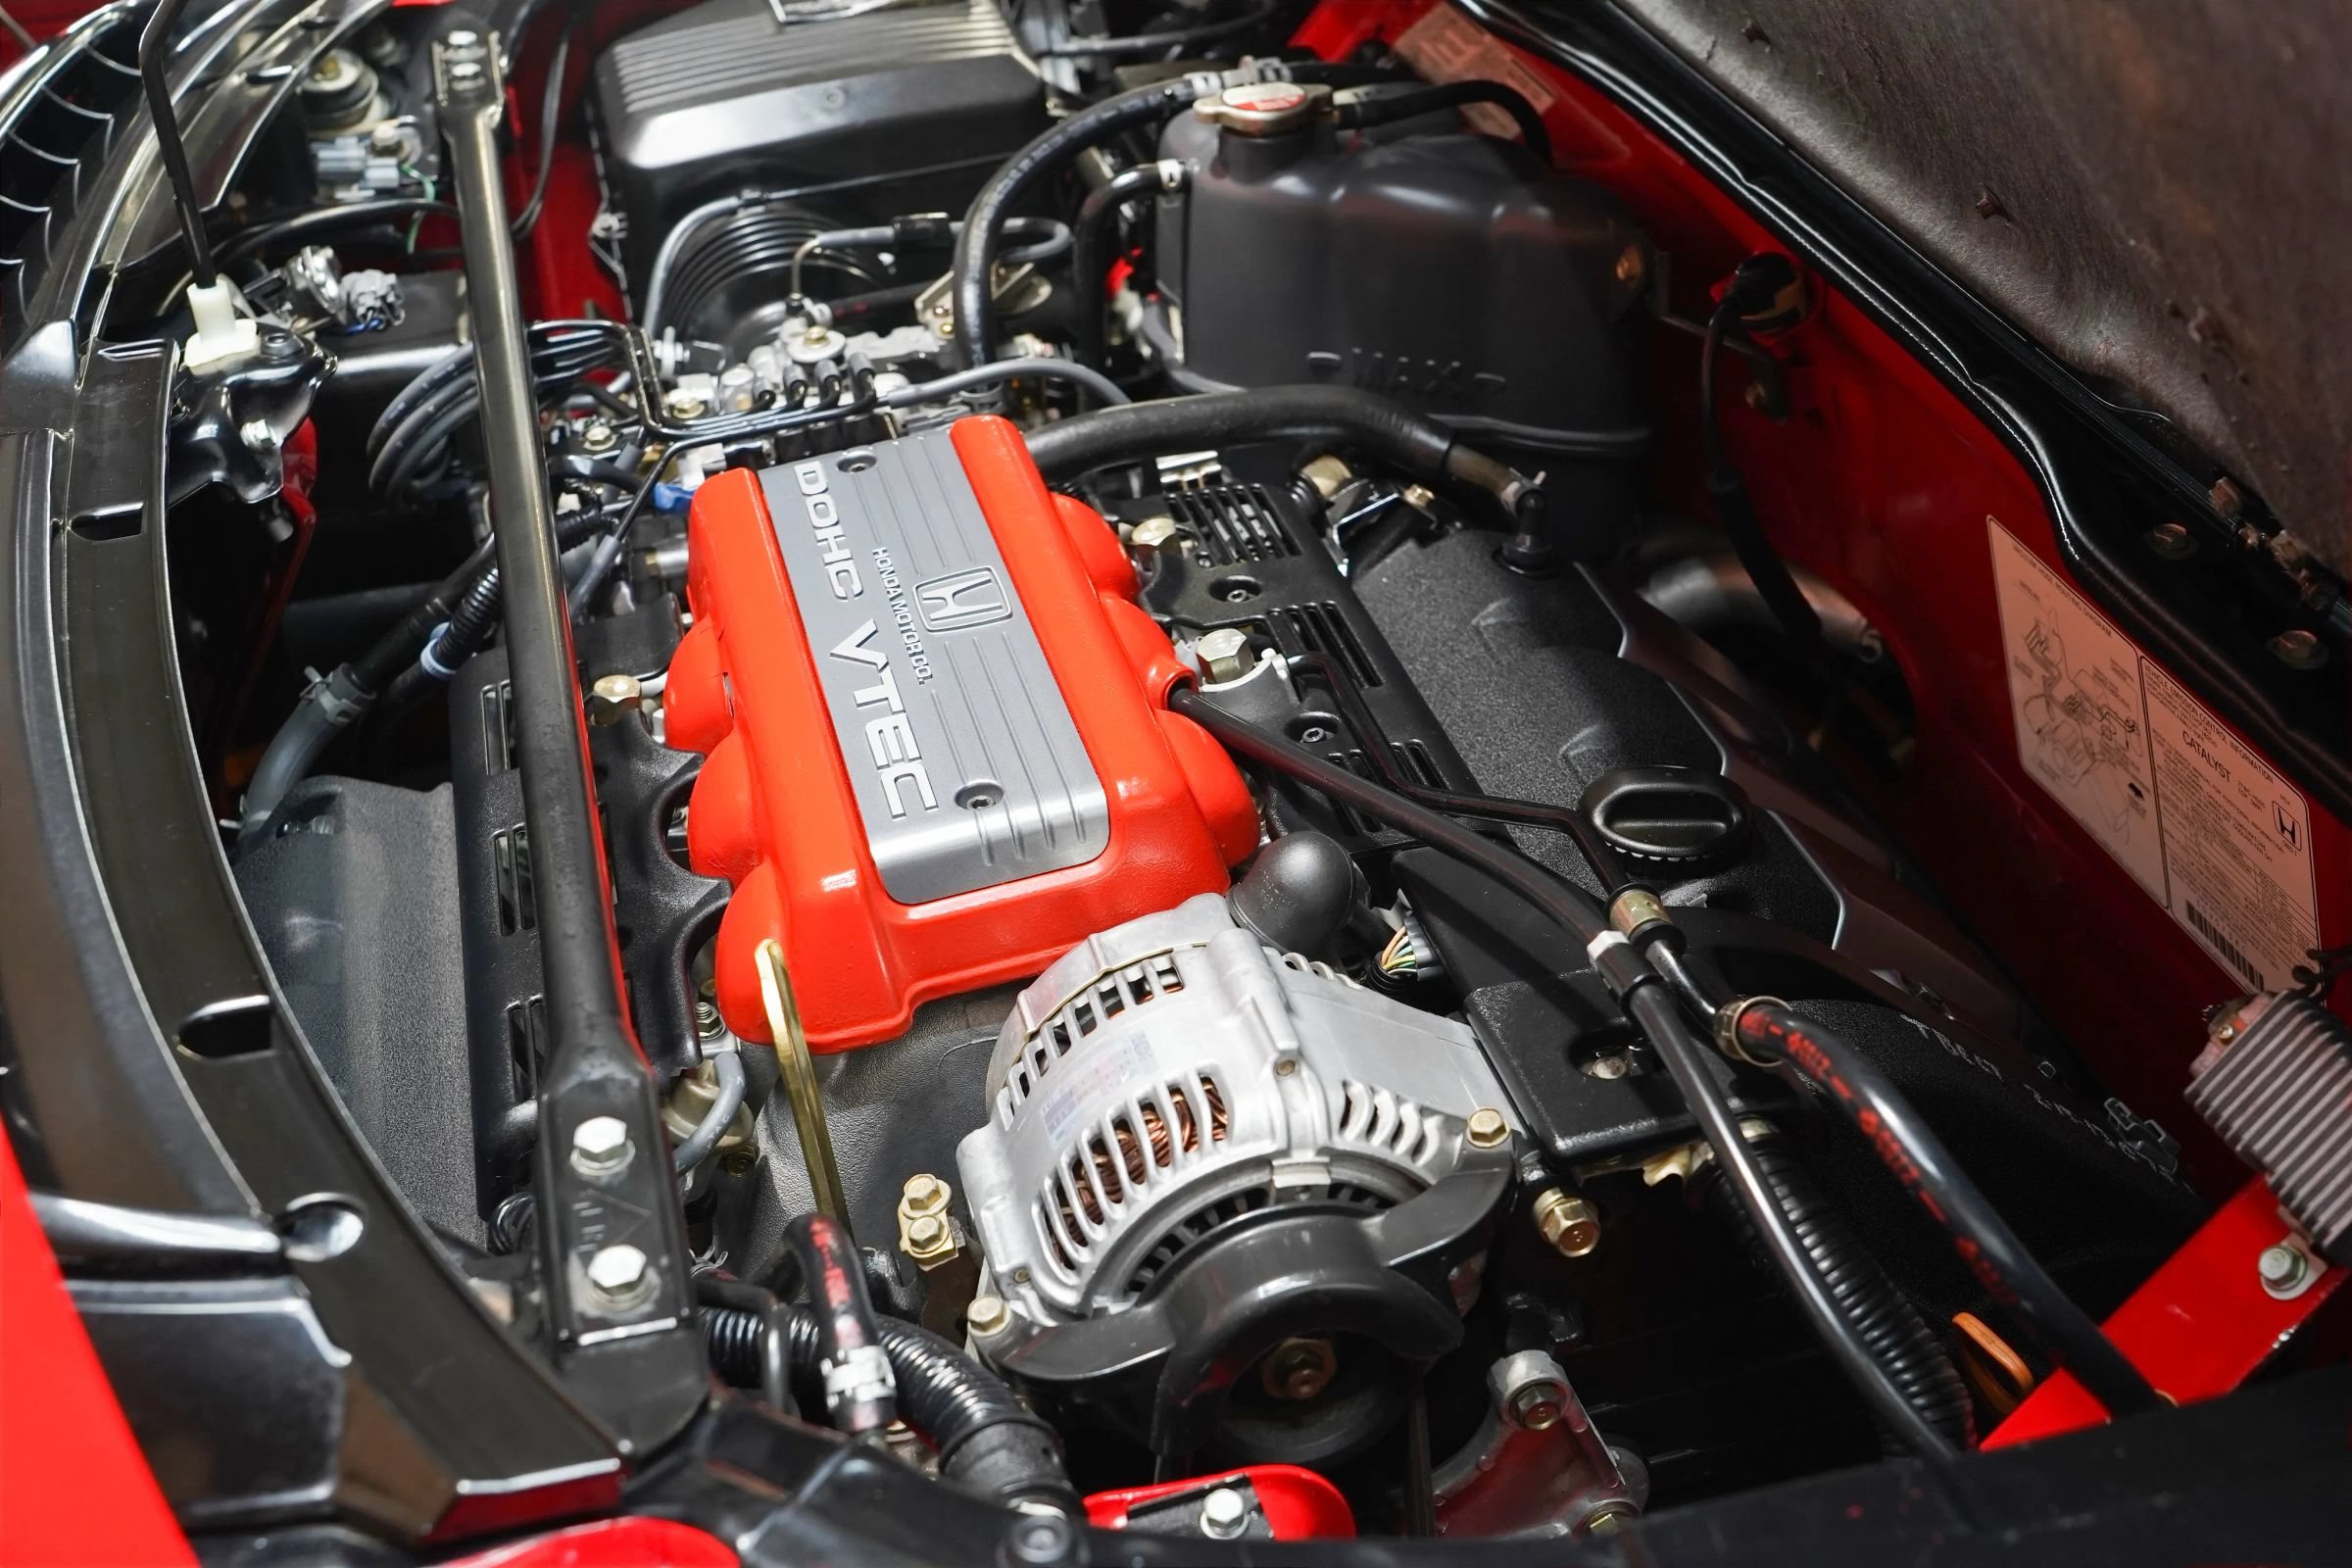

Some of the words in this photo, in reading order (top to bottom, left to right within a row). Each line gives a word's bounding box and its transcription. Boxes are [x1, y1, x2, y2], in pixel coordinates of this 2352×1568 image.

[794, 461, 863, 603] DOHC
[830, 618, 940, 820] VTEC
[872, 547, 903, 602] HONDA
[891, 599, 924, 658] MOTOR
[910, 655, 933, 685] CO.
[2182, 730, 2231, 783] CATALYST
[2199, 712, 2228, 744] CONTROL
[2230, 740, 2274, 785] INFORMATION
